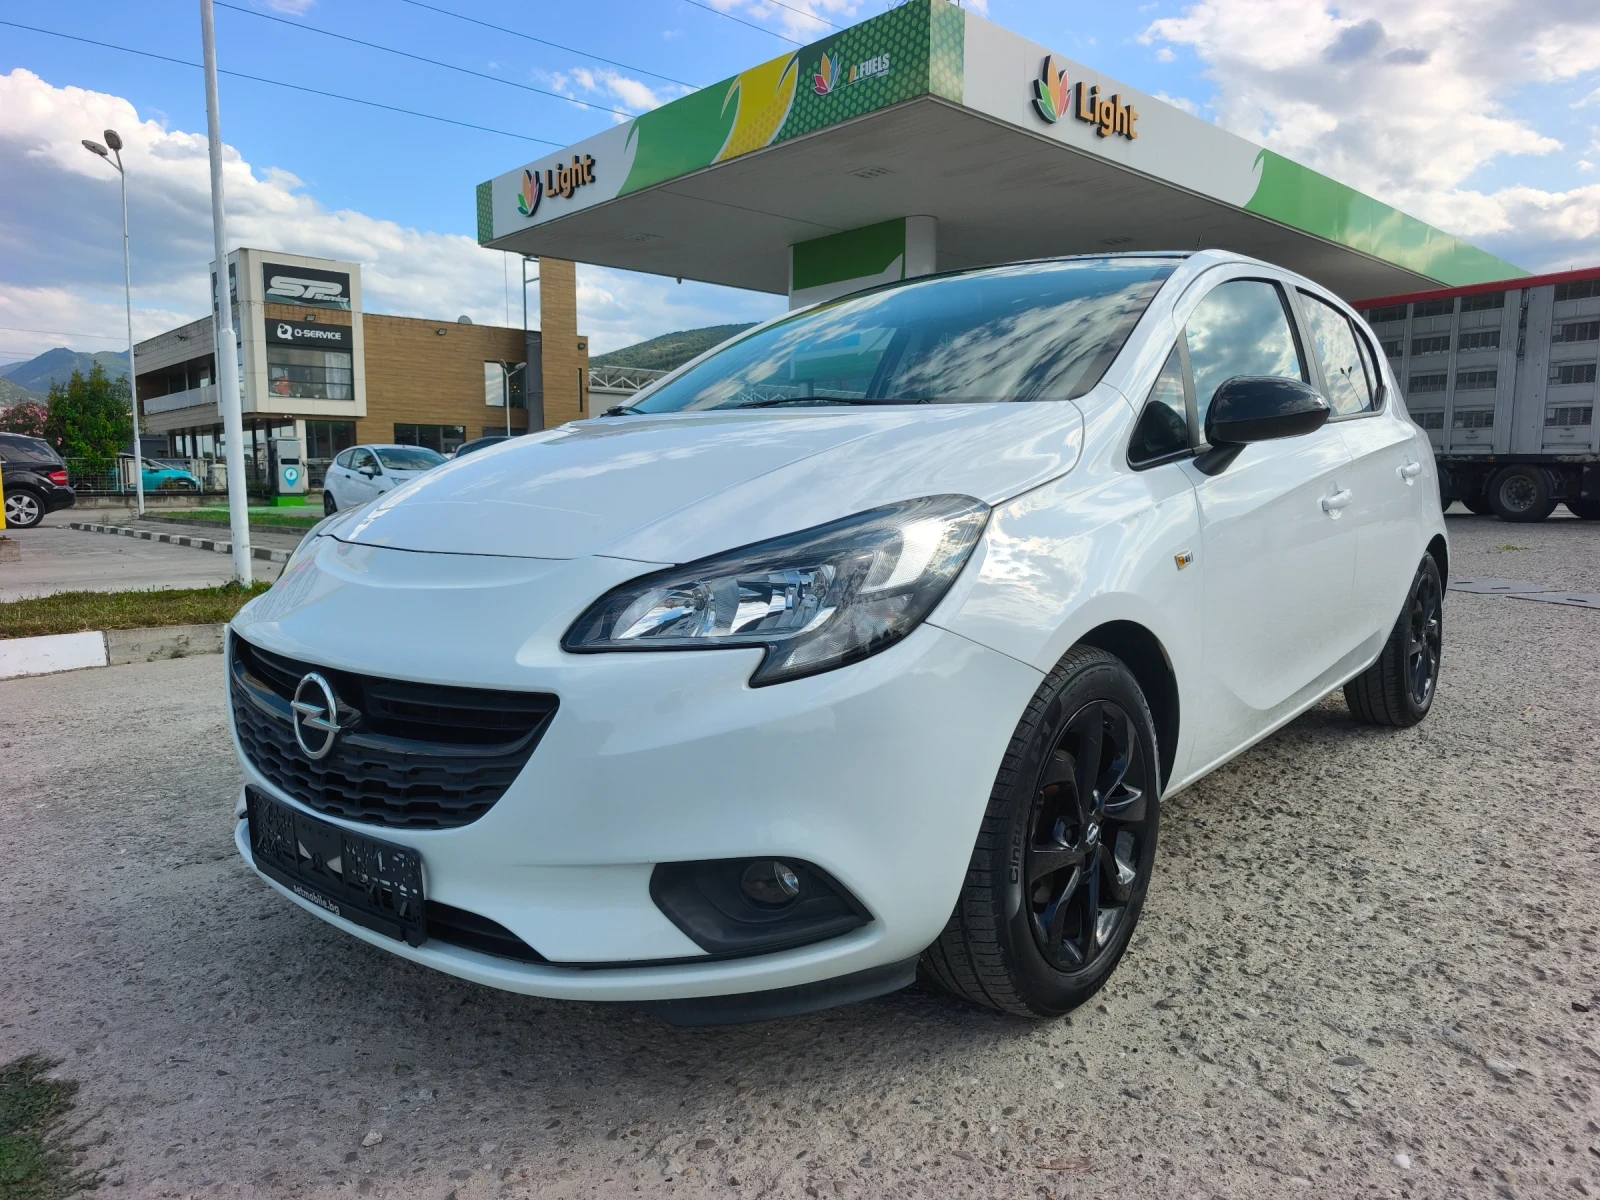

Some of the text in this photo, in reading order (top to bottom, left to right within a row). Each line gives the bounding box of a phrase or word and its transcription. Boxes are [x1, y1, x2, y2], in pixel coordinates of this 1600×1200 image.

[1076, 81, 1139, 140] Light
[545, 154, 595, 198] Light
[266, 275, 343, 299] SP
[313, 293, 349, 303] Service
